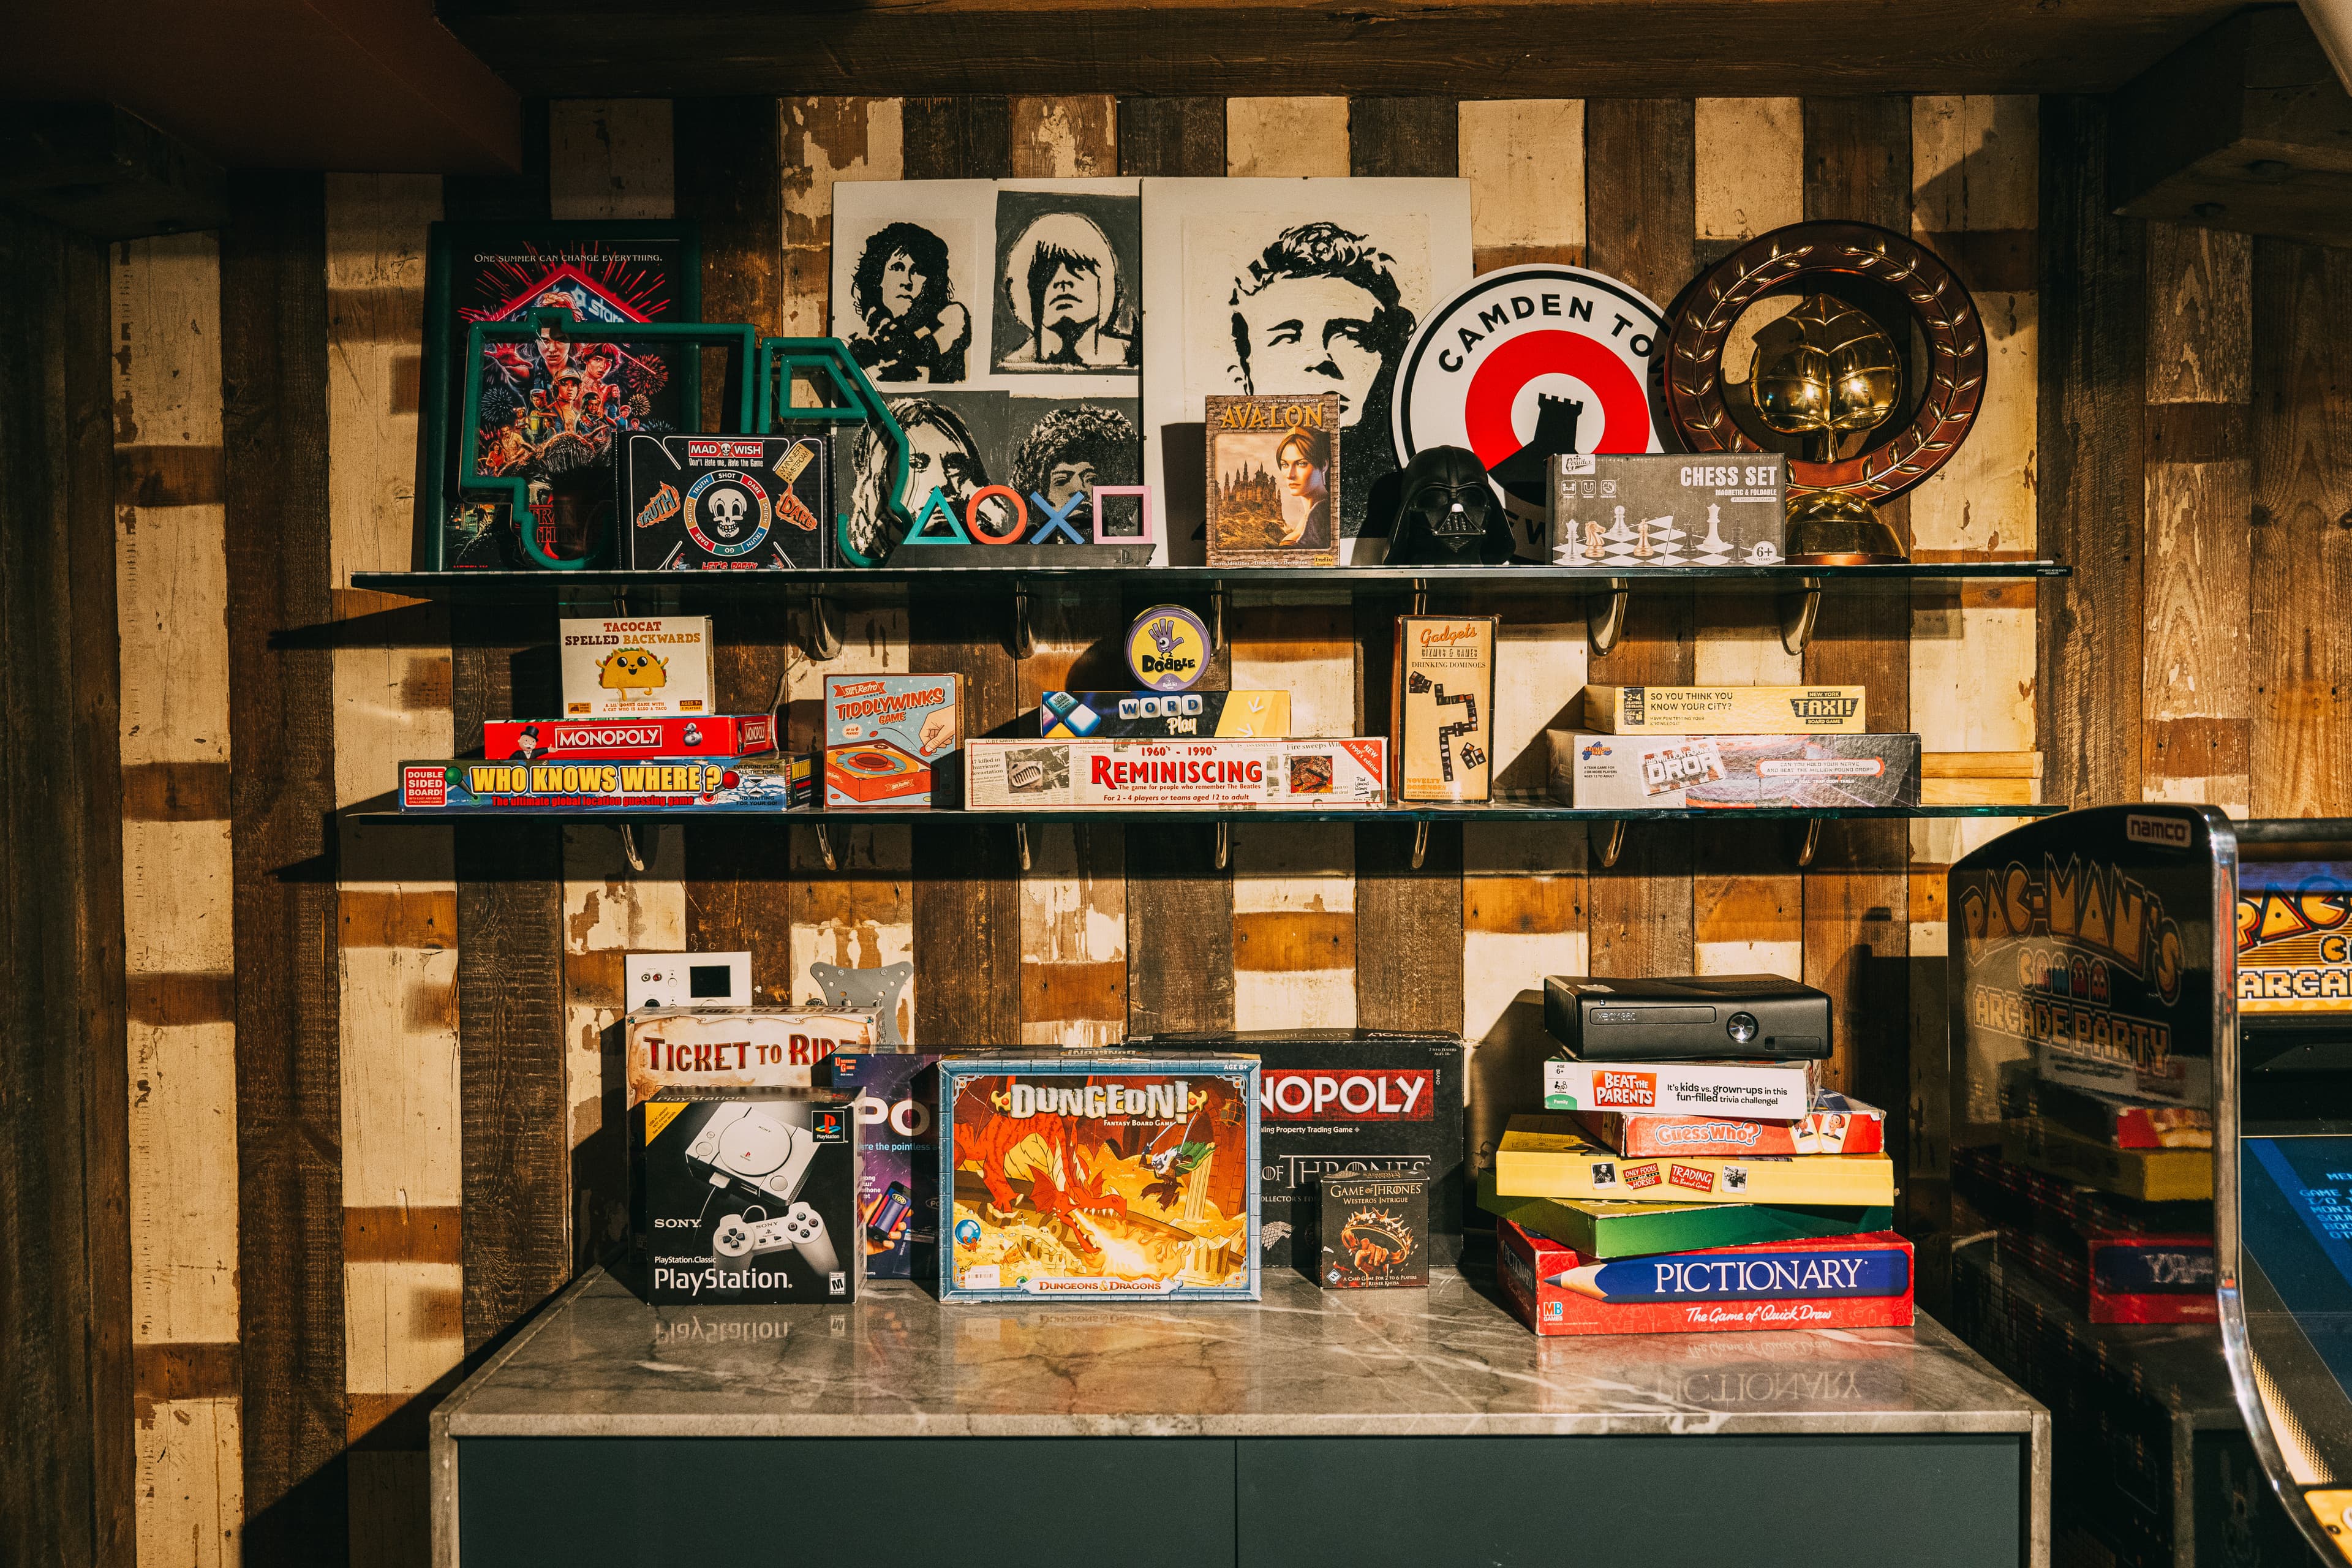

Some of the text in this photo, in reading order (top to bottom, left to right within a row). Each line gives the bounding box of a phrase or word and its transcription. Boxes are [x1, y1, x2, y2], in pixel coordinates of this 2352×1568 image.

[1439, 294, 1594, 373] CAMDEN
[1219, 402, 1324, 428] AVALON
[690, 445, 761, 454] MAD WISH
[688, 458, 703, 466] Don't
[750, 459, 763, 467] Game
[1680, 466, 1777, 486] CHESS SET
[693, 478, 709, 494] TRUTH
[747, 479, 761, 494] DARE
[639, 489, 676, 526] TRUTH
[780, 495, 815, 529] DARE
[1757, 546, 1773, 557] 6+
[603, 621, 662, 633] TACOCAT
[1420, 622, 1477, 647] Gadgets
[565, 633, 701, 646] SPELLED BACKWARDS
[1142, 655, 1196, 673] DOBBLE
[834, 686, 945, 721] TIDDLYWINKS
[1121, 699, 1199, 715] WORD
[1795, 700, 1852, 715] TAXI!
[878, 711, 907, 725] GAME
[1167, 715, 1197, 736] Play
[559, 729, 659, 747] MONOPOLY
[745, 725, 766, 742] MONOPOLY
[1349, 742, 1379, 774] 1990's edition
[1363, 745, 1379, 758] NEW
[1091, 755, 1263, 790] REMINISCING
[1646, 753, 1720, 785] DROP
[472, 766, 722, 793] WHO KNOWS WHERE ?
[492, 796, 695, 807] The ultimate global location guessing game
[2130, 819, 2186, 842] namco
[1960, 853, 2184, 1006] PAC-MAN'S
[1597, 1012, 1621, 1021] XBOX
[1973, 986, 2170, 1076] ARCADE PARTY
[643, 1033, 857, 1072] TICKET TO RID
[1605, 1072, 1637, 1089] BEAT
[1680, 1082, 1699, 1092] kids
[1713, 1085, 1763, 1095] grown-ups
[1010, 1080, 1189, 1125] DUNGEON!
[1261, 1076, 1426, 1114] NOPOLY
[1596, 1087, 1654, 1104] PARENTS
[1676, 1092, 1718, 1102] fun-filled
[1741, 1096, 1778, 1106] challenge!
[891, 1142, 931, 1152] pointless
[1625, 1164, 1657, 1178] ONLY FOOLS
[1673, 1165, 1713, 1185] TRADING
[1330, 1185, 1363, 1197] GAME
[1371, 1183, 1423, 1196] THRONES
[1633, 1177, 1656, 1189] HORSES
[894, 1194, 905, 1204] 100
[654, 1218, 700, 1228] SONY
[655, 1268, 789, 1296] PlayStation
[1654, 1259, 1864, 1294] PICTIONARY
[1039, 1281, 1098, 1291] DUNGEONS
[1109, 1280, 1161, 1291] DRAGONS
[1544, 1302, 1563, 1316] MB
[1686, 1303, 1831, 1322] The Game of Quick Draw
